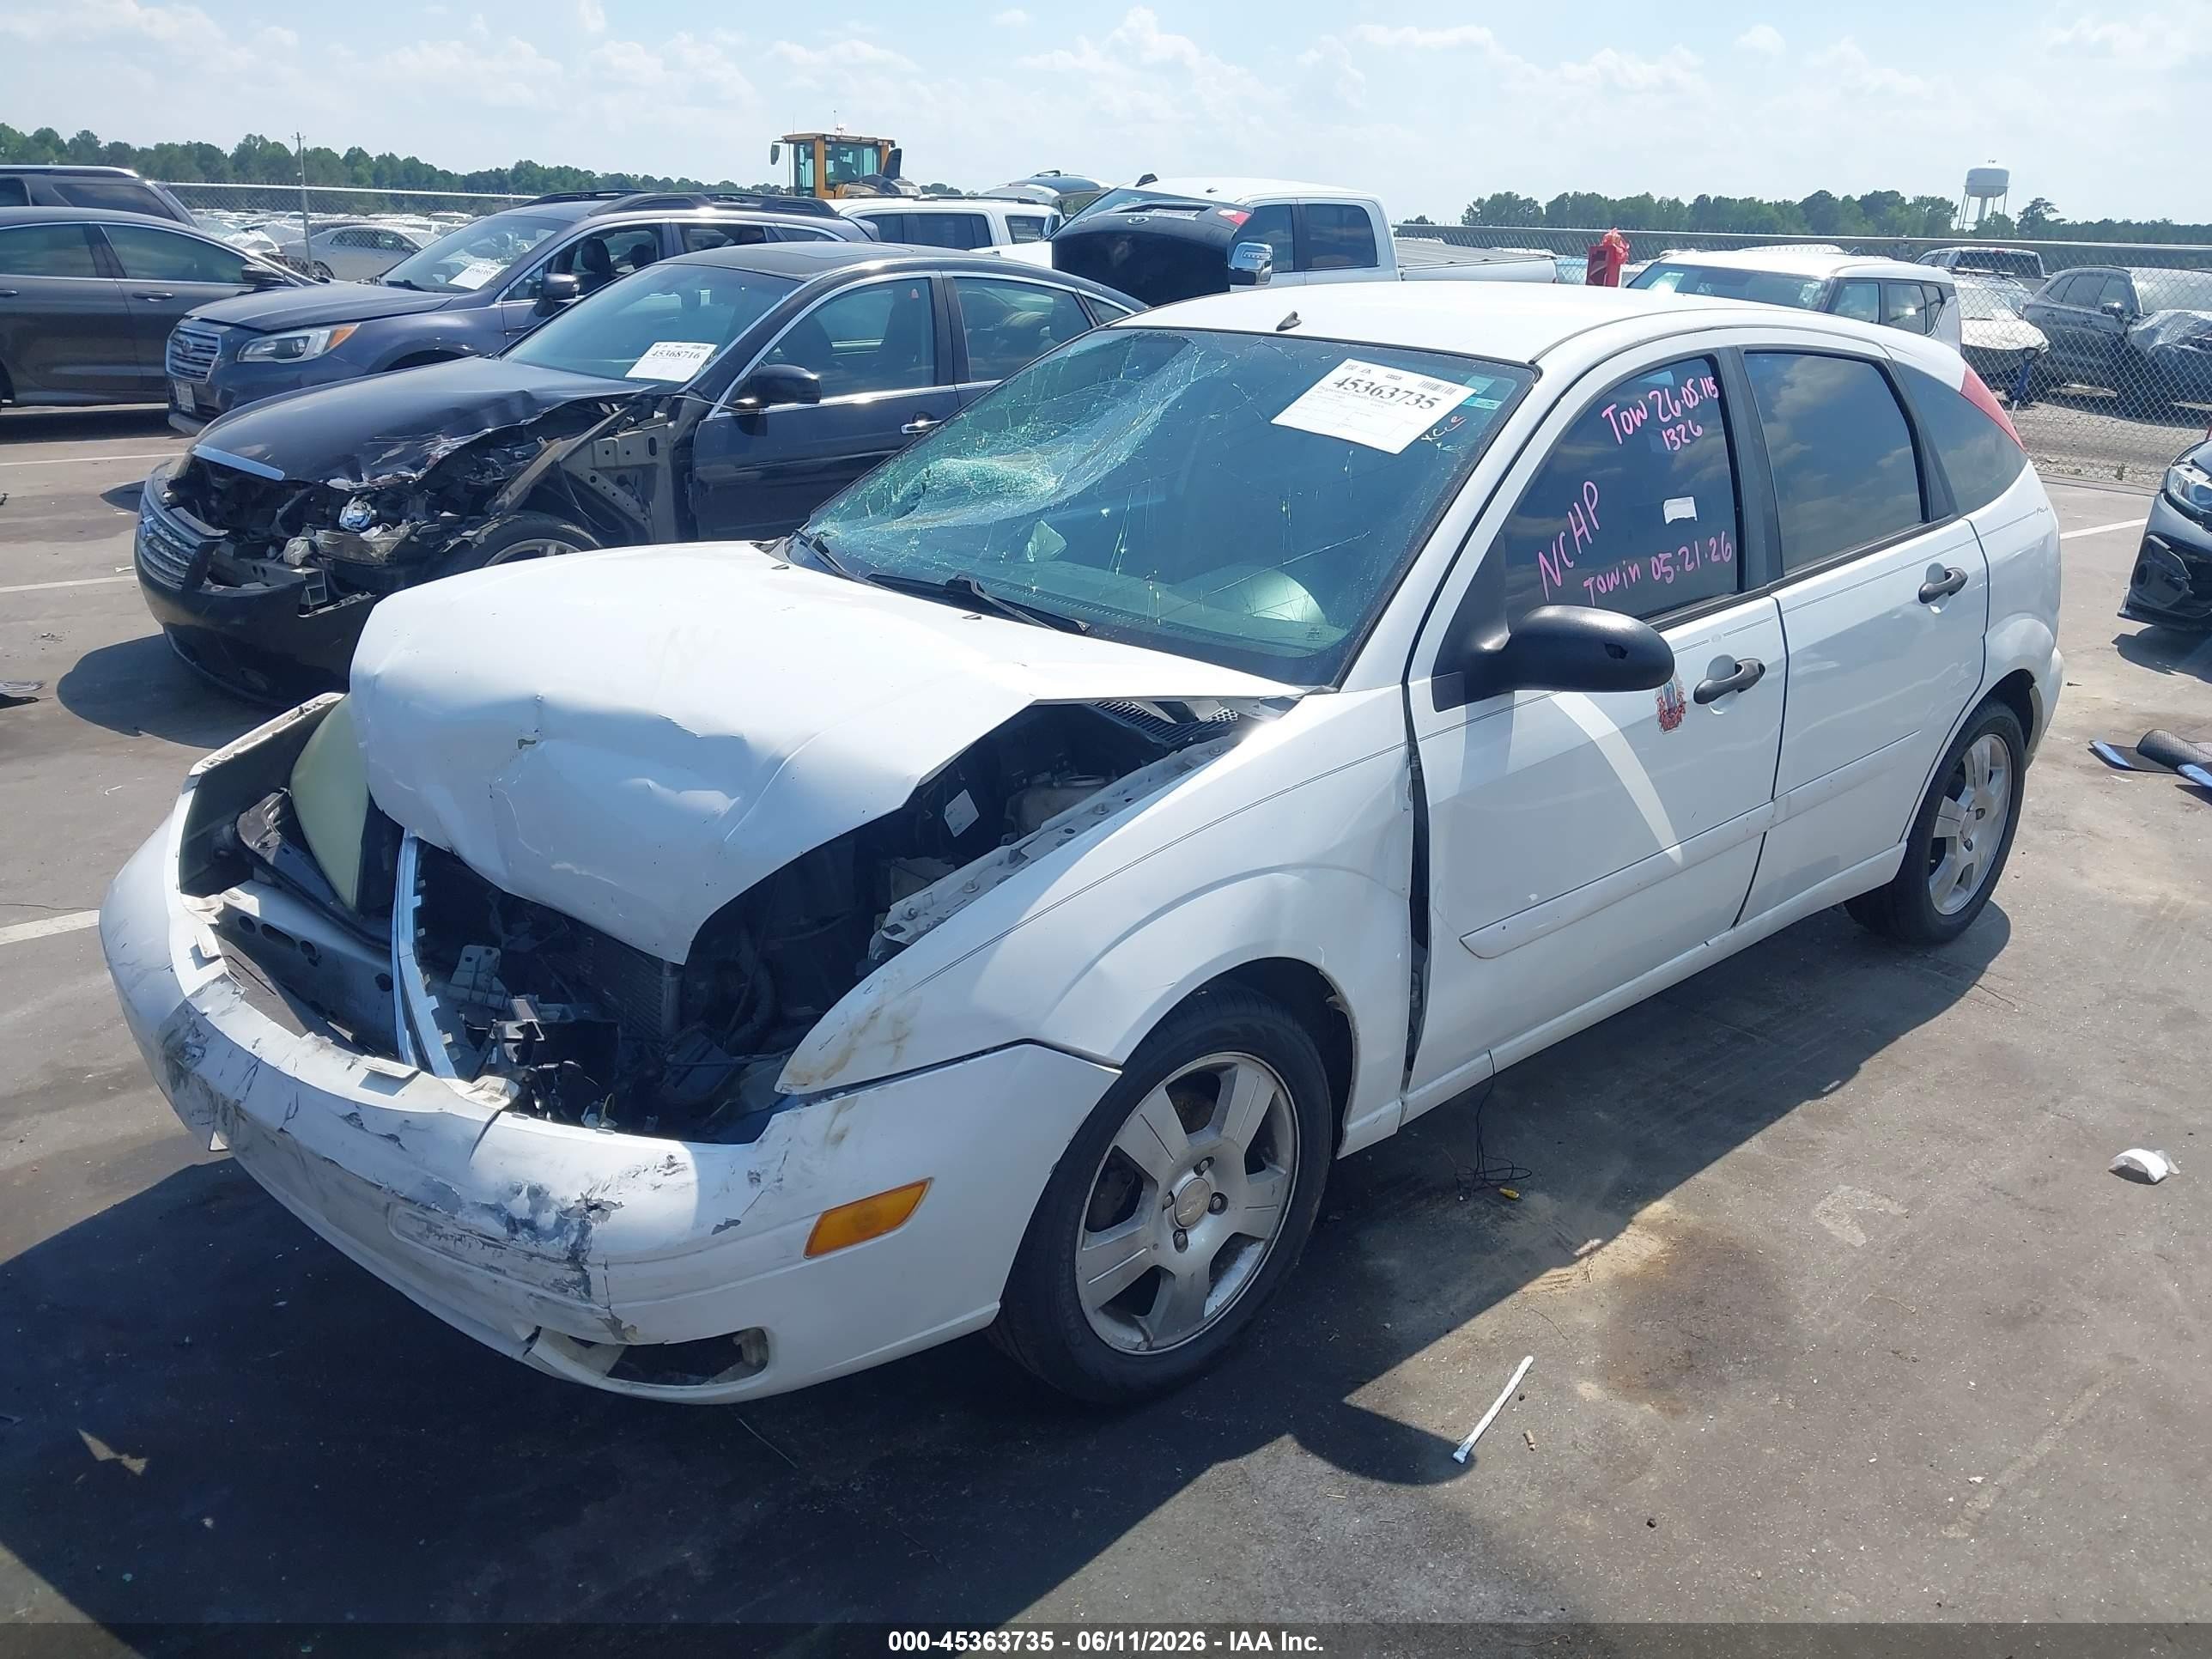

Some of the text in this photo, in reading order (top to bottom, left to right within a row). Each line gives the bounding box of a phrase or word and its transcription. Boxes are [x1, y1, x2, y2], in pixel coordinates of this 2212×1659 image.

[1333, 375, 1442, 410] 45363735
[1662, 419, 1704, 452] 1326
[1538, 482, 1600, 601] NCHP
[1650, 531, 1733, 584] 05.21.26
